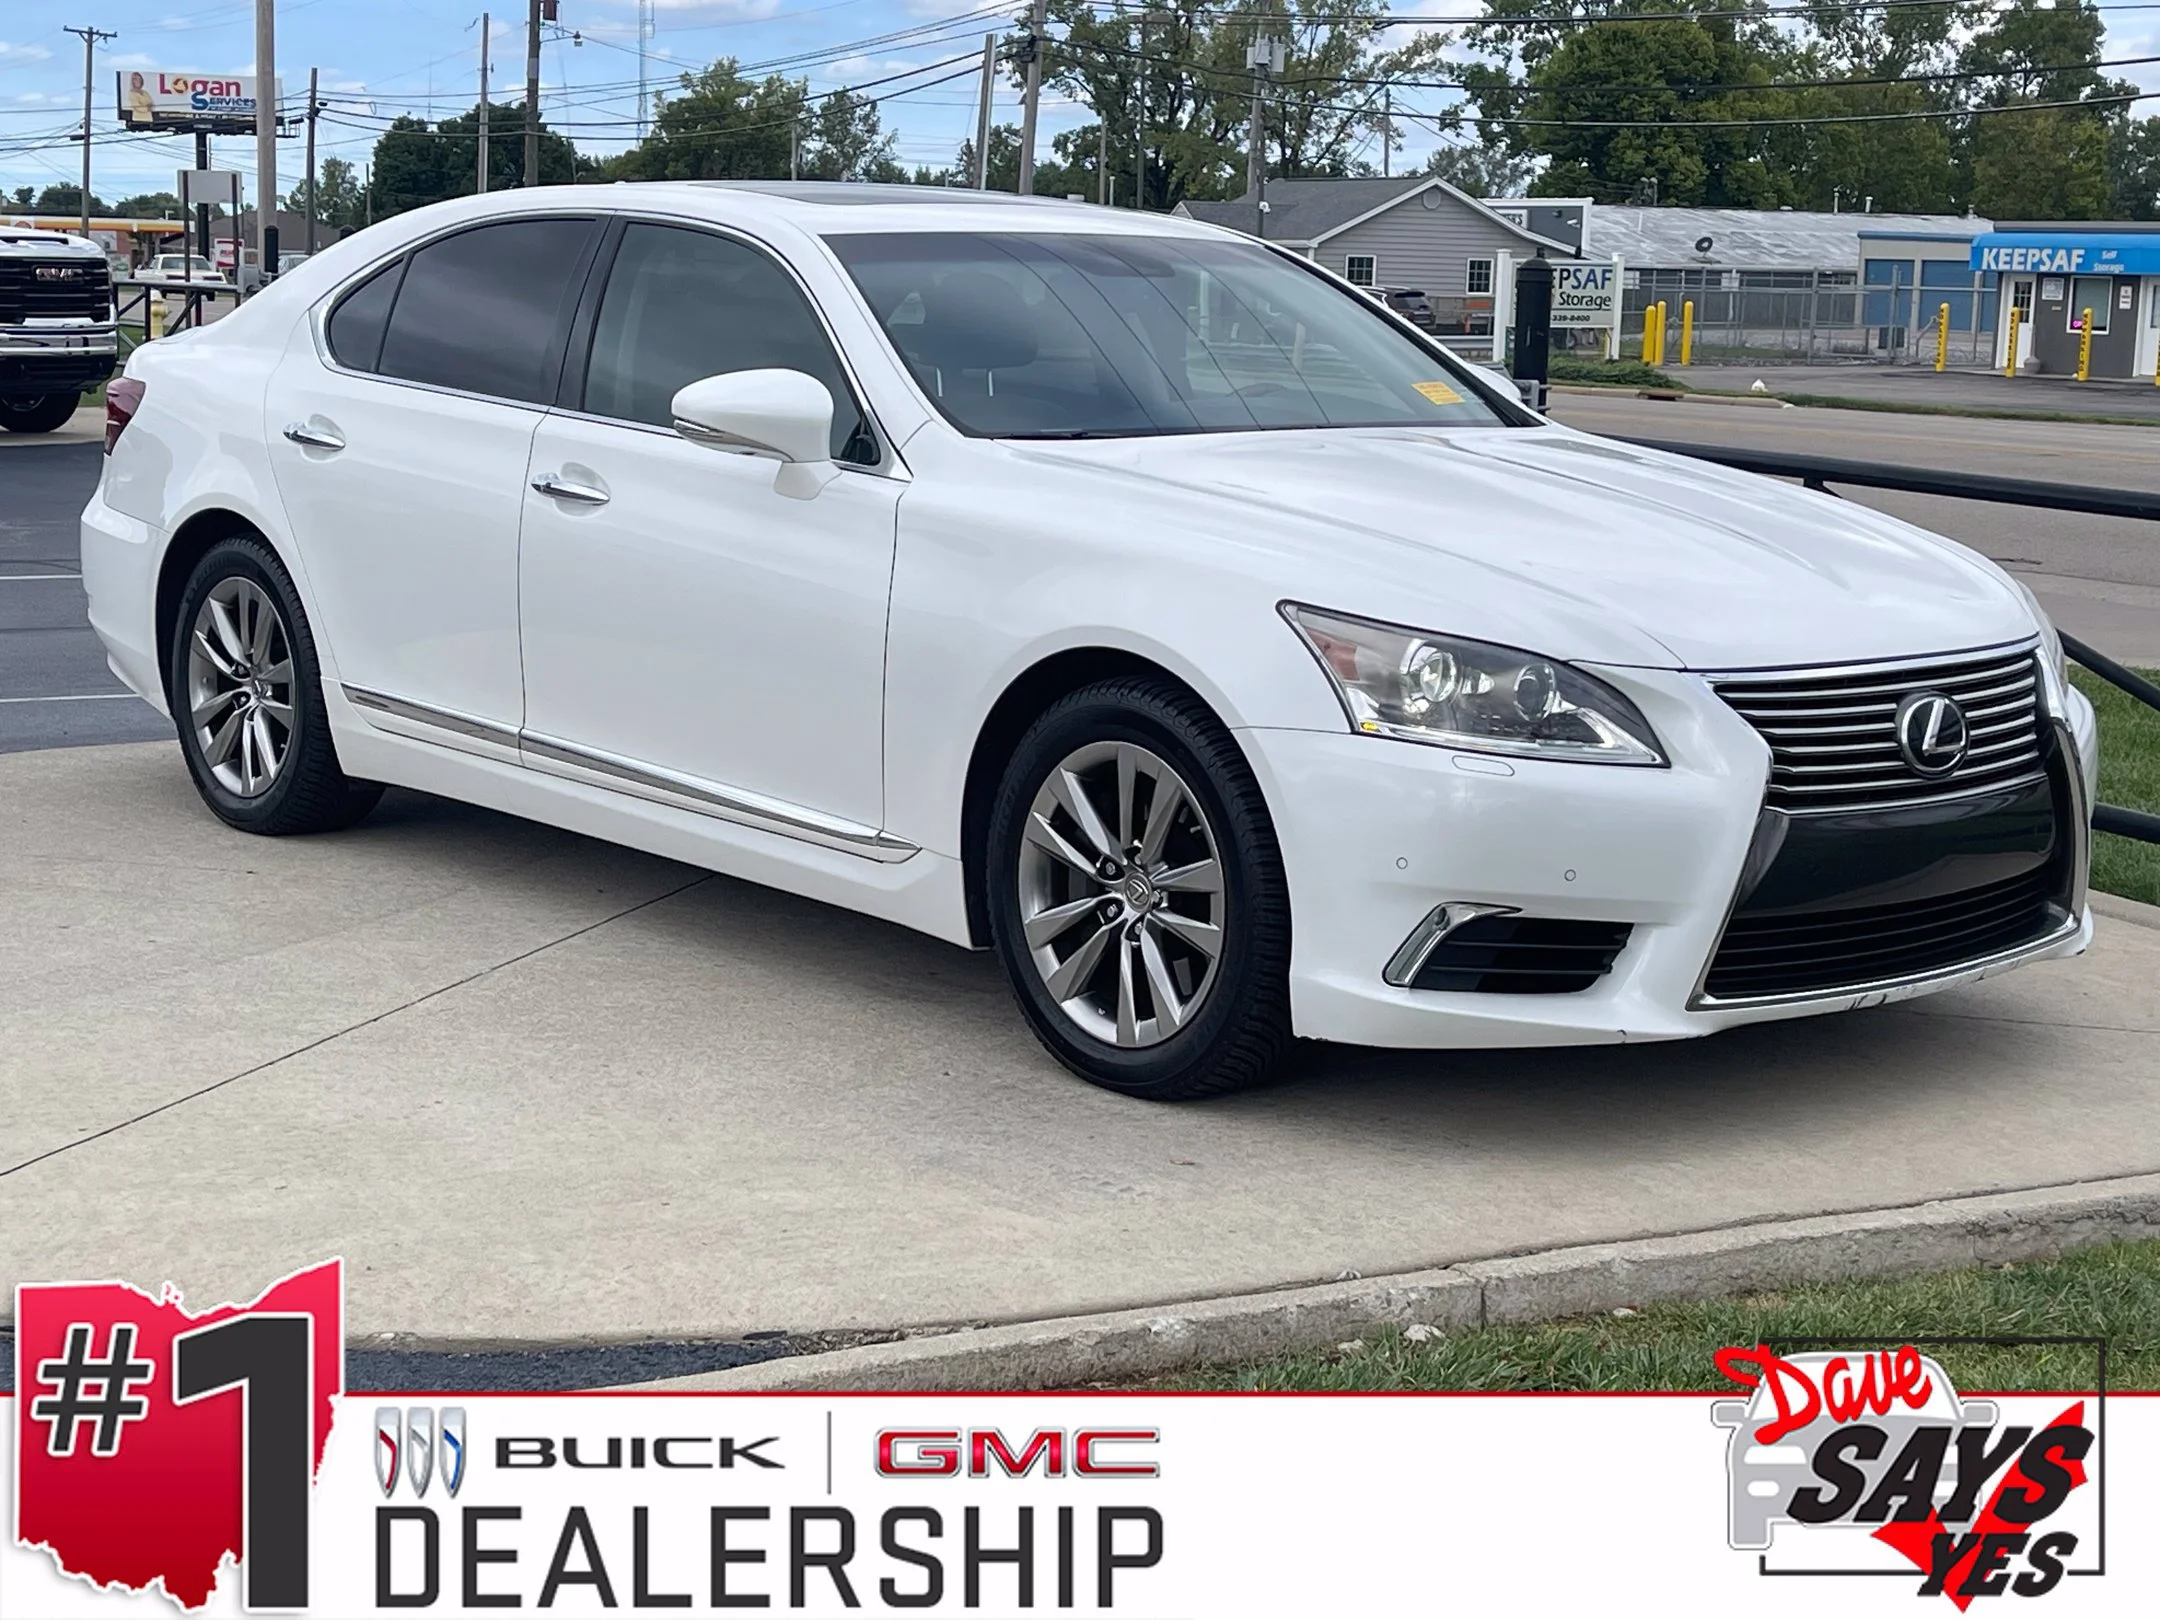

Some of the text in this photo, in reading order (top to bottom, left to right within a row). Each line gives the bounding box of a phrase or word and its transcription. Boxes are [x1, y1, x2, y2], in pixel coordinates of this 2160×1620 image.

[159, 73, 241, 97] Logan
[1981, 248, 2085, 272] KEEPSAF
[2092, 263, 2125, 273] Storage
[1551, 268, 1613, 290] PSAF
[1558, 291, 1612, 311] Storage
